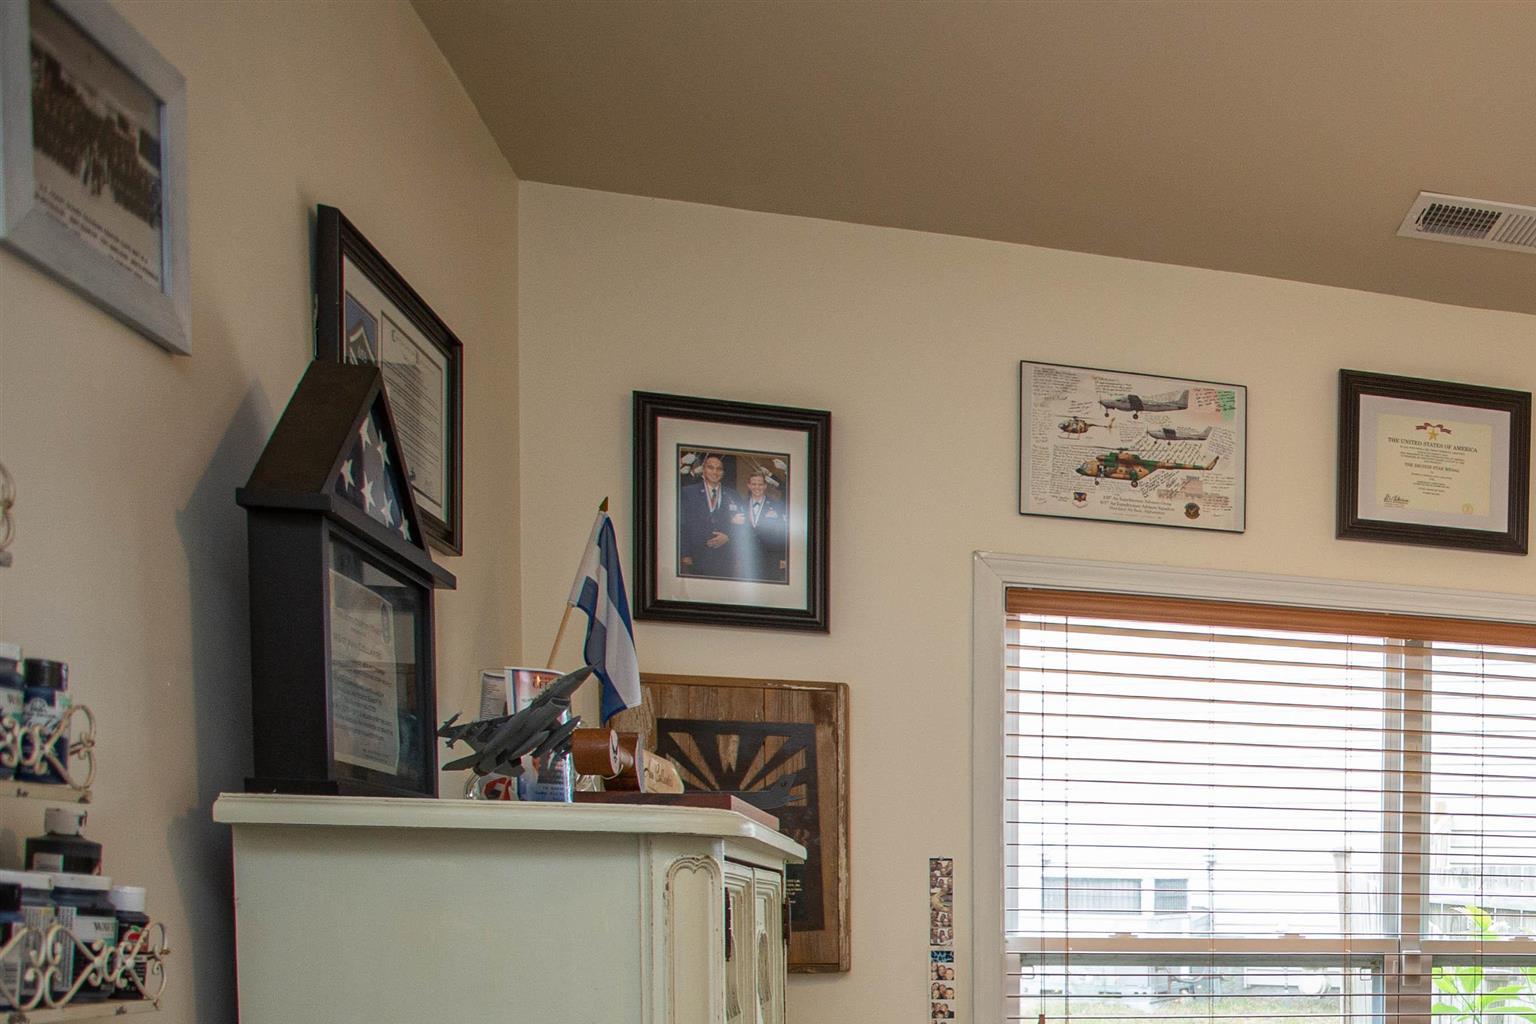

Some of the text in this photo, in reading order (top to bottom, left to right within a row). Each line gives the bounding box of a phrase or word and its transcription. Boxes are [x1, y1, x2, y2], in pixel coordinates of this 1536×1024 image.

[1401, 438, 1422, 446] UNITED
[1423, 441, 1443, 449] STATES
[1453, 445, 1478, 453] AMERICA
